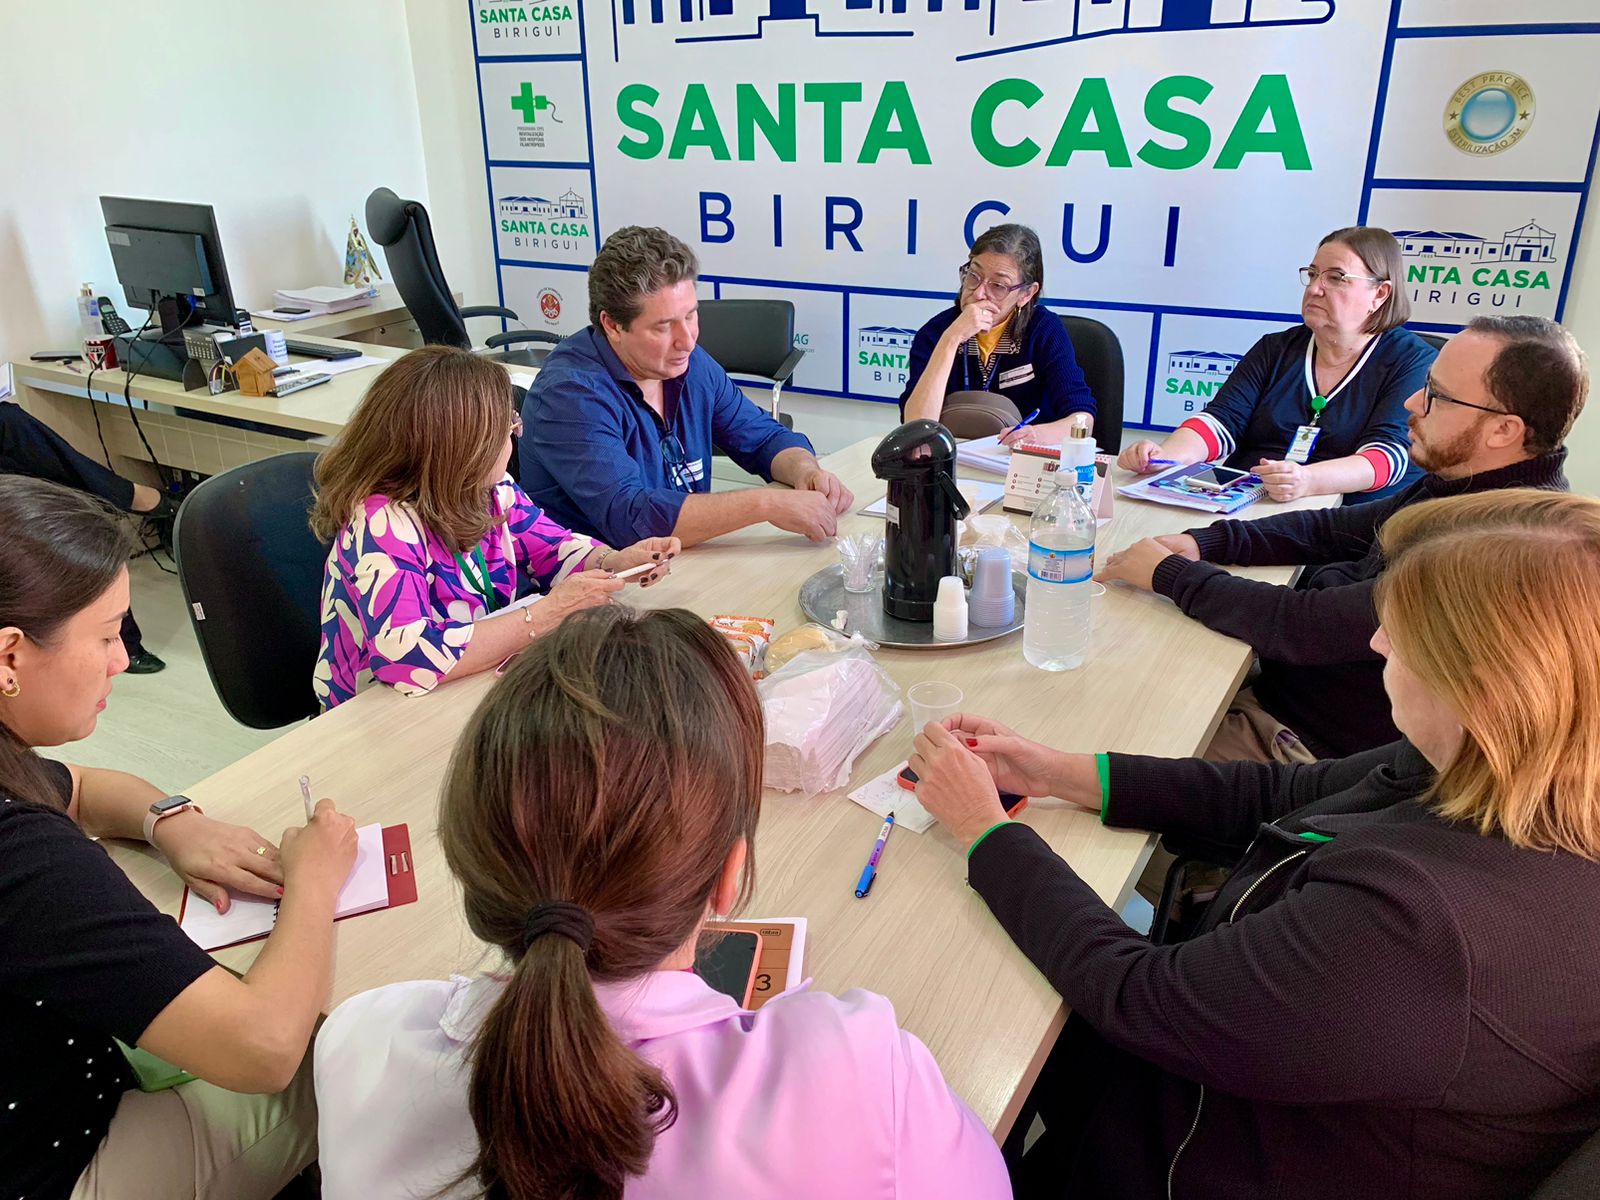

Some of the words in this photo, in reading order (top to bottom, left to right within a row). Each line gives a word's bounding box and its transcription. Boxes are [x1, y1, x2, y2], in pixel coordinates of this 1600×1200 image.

[480, 7, 527, 24] SANTA
[531, 5, 573, 21] CASA
[493, 26, 561, 38] BIRIGUI
[1454, 81, 1477, 104] BEST
[1482, 74, 1530, 101] PRACTICE
[616, 81, 932, 166] SANTA
[970, 74, 1312, 171] CASA
[1510, 127, 1522, 142] 3M
[501, 219, 546, 235] SANTA
[550, 222, 589, 238] CASA
[514, 236, 578, 251] BIRIGUI
[1407, 264, 1462, 286] NTA
[1471, 267, 1550, 290] CASA
[1413, 289, 1521, 308] IRIGUI
[858, 351, 909, 370] SANT
[1165, 377, 1224, 397] SANT
